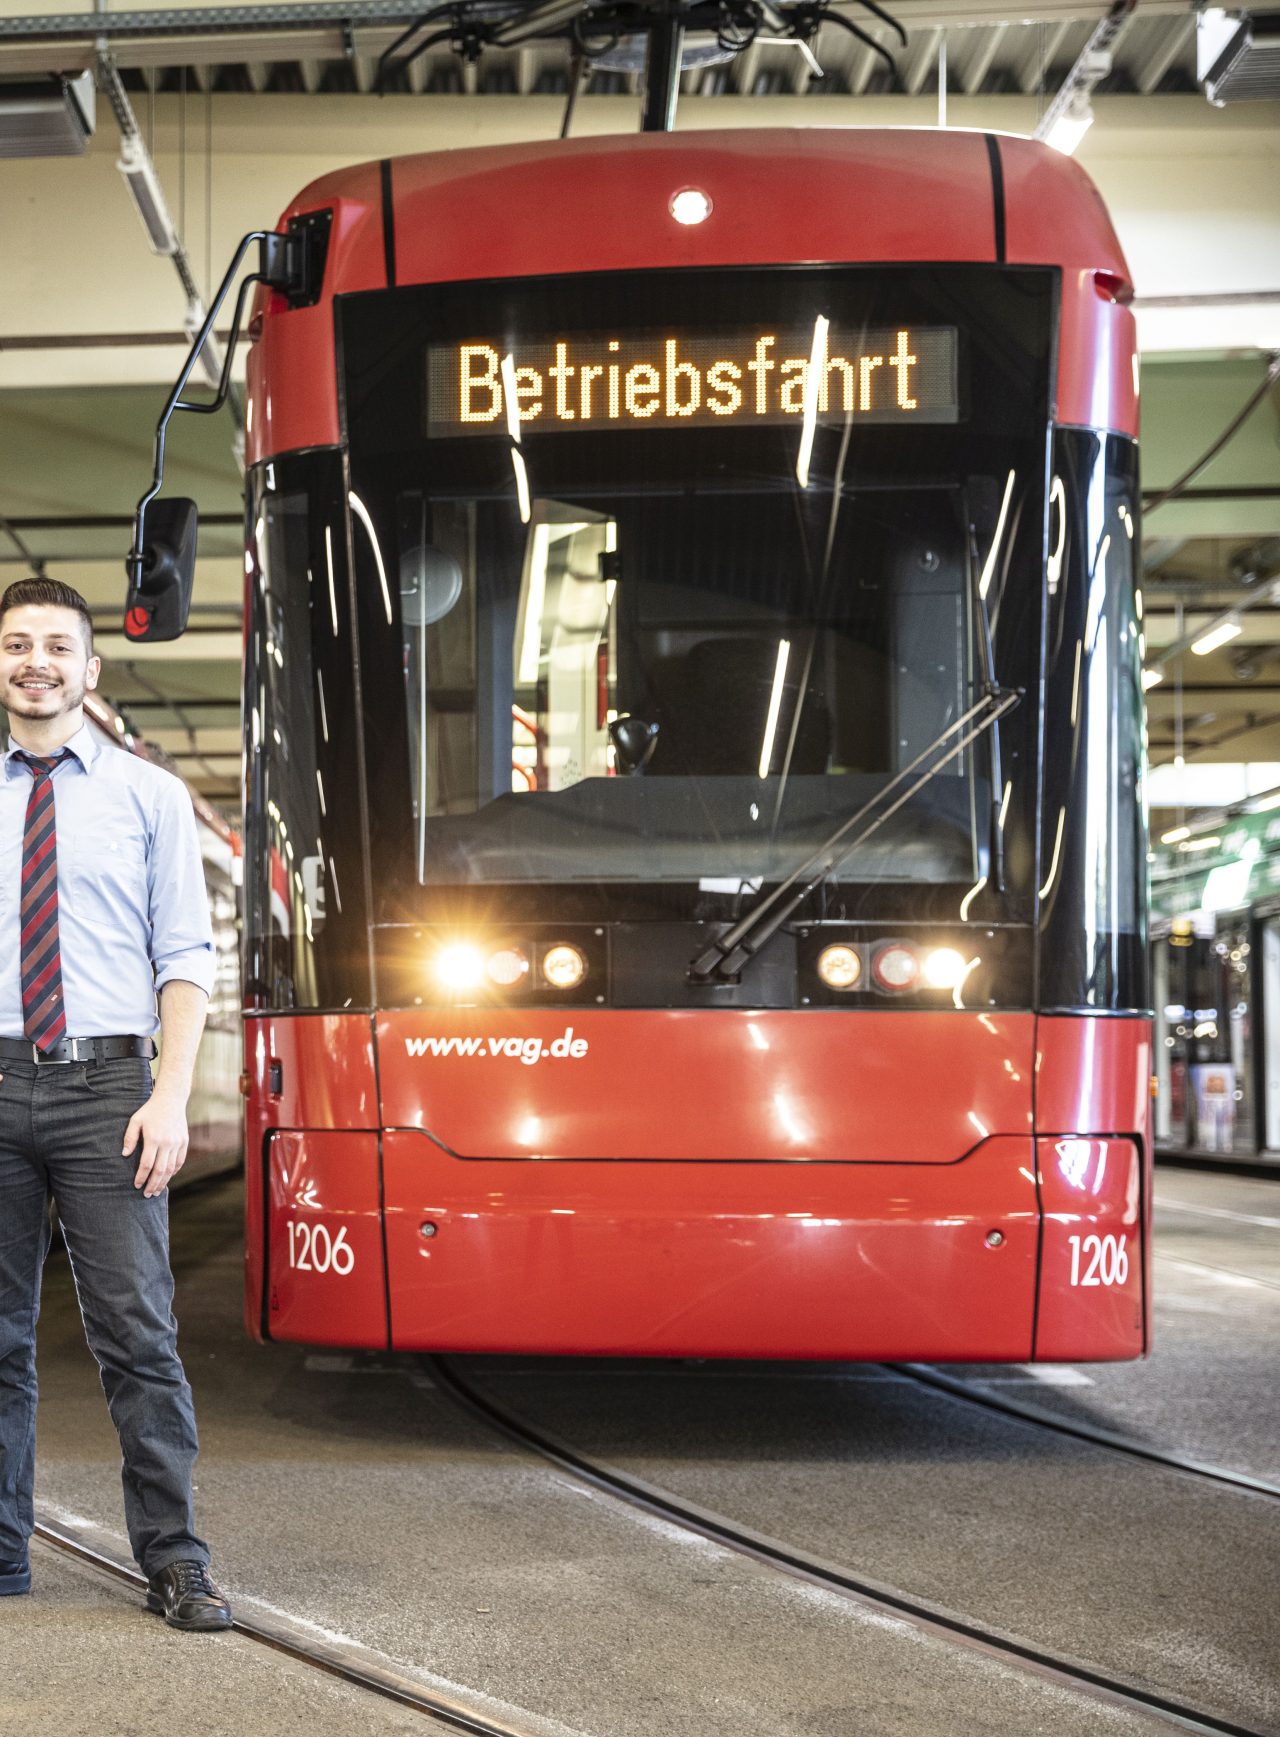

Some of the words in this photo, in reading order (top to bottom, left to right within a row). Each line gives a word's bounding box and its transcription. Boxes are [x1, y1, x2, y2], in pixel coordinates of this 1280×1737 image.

[459, 331, 917, 422] Betriebsfahrt
[404, 1026, 589, 1065] www.vag.de
[286, 1220, 355, 1276] 1206
[1067, 1233, 1129, 1287] 1206
